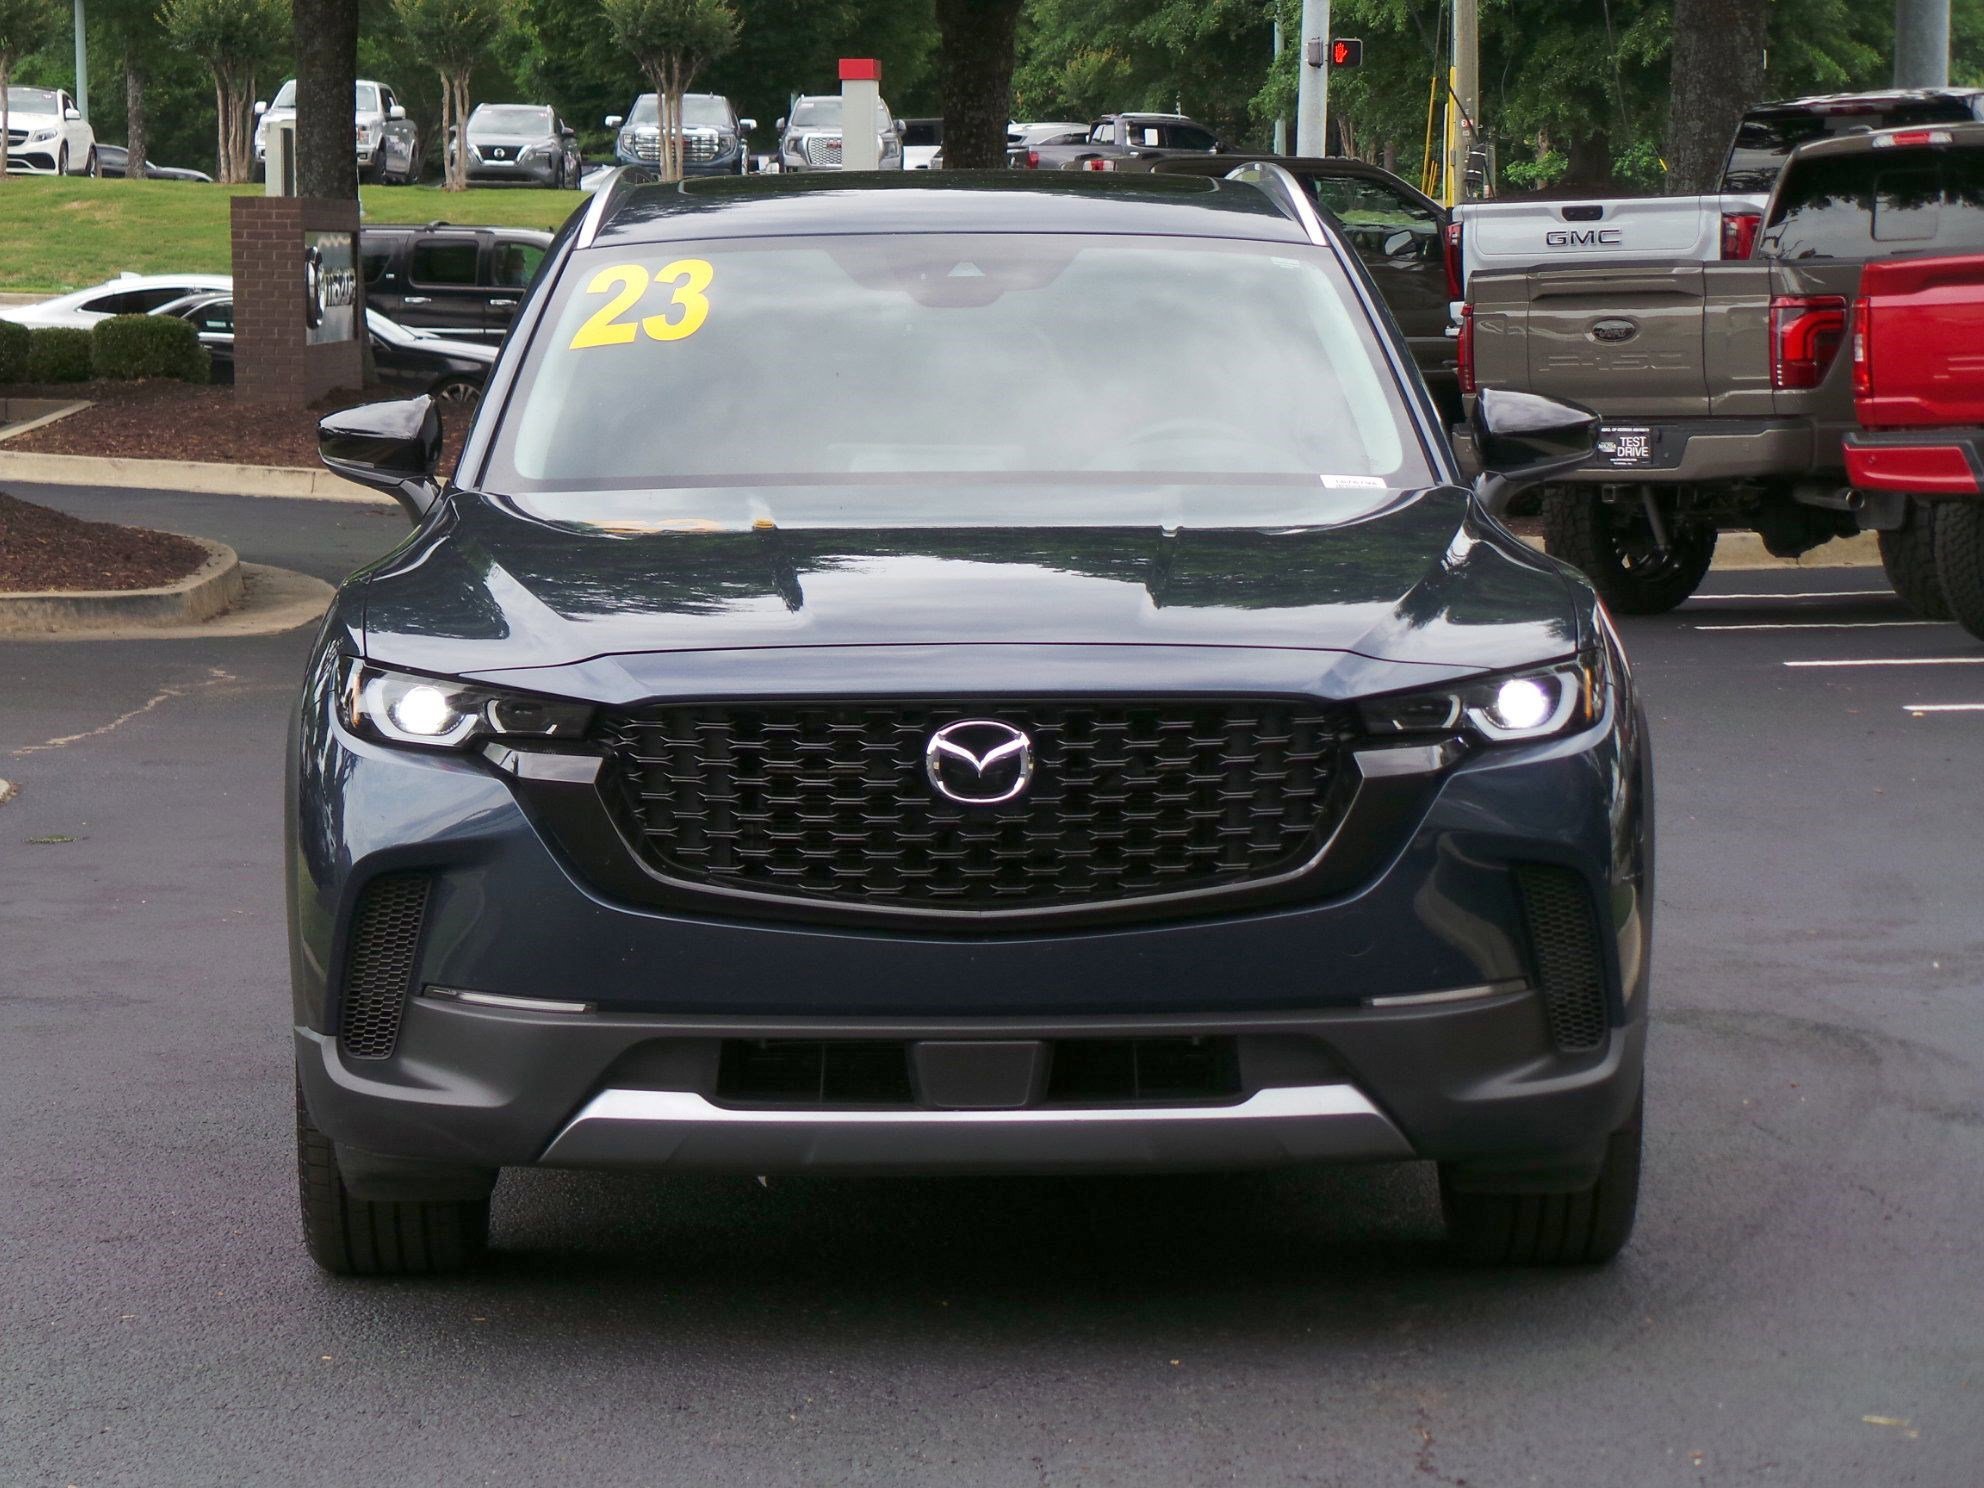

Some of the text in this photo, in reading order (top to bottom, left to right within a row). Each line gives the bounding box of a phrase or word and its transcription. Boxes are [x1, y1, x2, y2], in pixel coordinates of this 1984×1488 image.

[1546, 229, 1622, 246] GMC
[568, 258, 714, 350] 23
[1619, 436, 1647, 447] TEST
[1617, 446, 1649, 457] DRIVE
